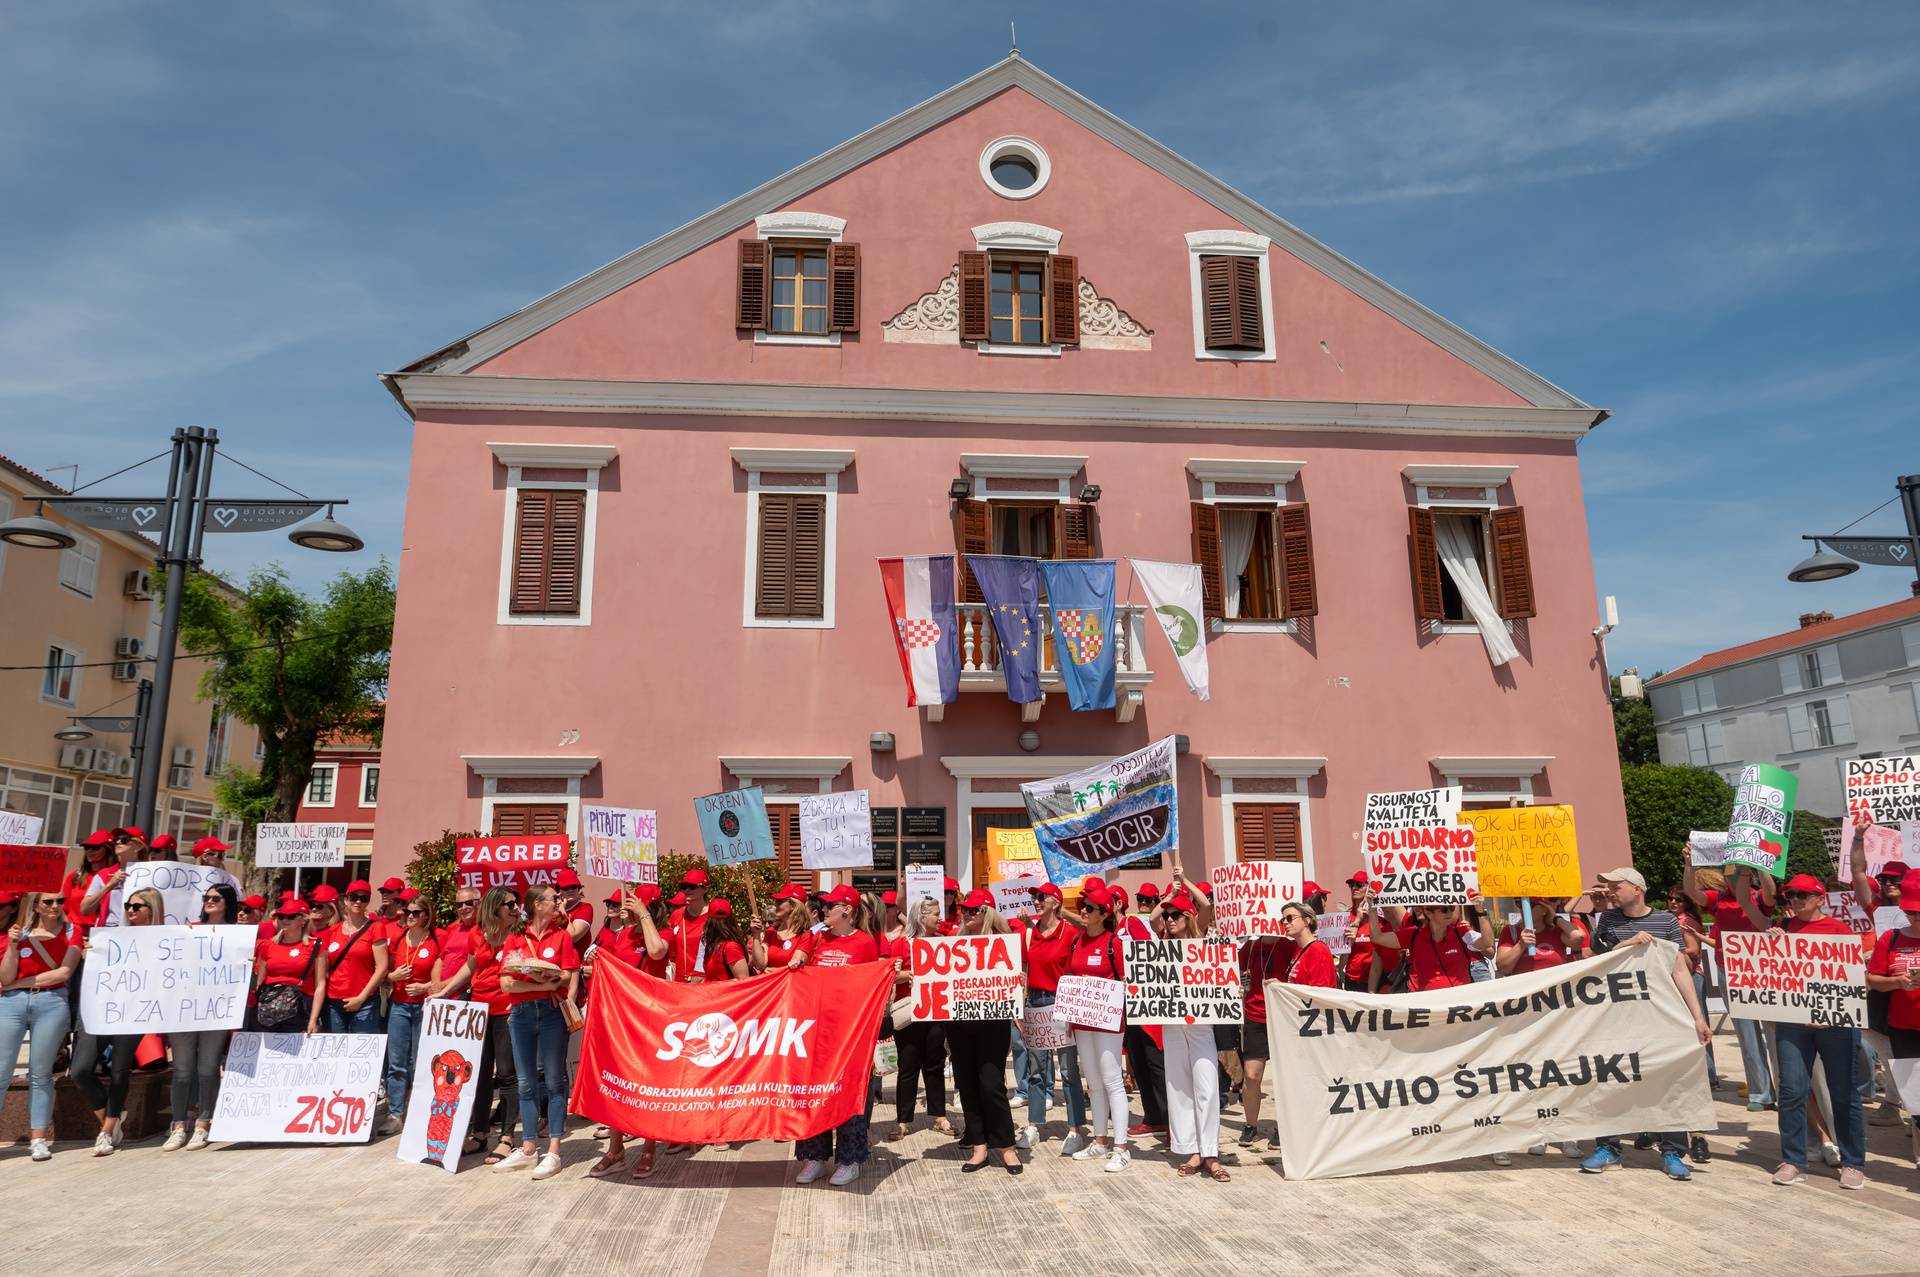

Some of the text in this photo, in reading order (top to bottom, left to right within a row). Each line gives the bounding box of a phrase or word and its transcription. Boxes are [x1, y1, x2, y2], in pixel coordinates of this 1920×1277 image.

[243, 508, 304, 516] BIOGRAD
[1849, 757, 1914, 775] DOSTA
[1368, 790, 1450, 806] SIGURNOST I
[1736, 785, 1783, 806] BILO
[1848, 786, 1908, 798] DIGNITET
[704, 793, 746, 812] OKRENI
[853, 794, 868, 812] JE
[1849, 798, 1870, 811] ZA
[1368, 805, 1438, 821] KVALITETA
[1508, 813, 1527, 832] JE
[1850, 810, 1874, 826] ZA
[294, 825, 316, 838] NIJE
[590, 809, 656, 840] PITAJTE VAŠE
[814, 836, 826, 851] DI
[832, 836, 844, 848] SI
[1000, 832, 1034, 844] STOP
[1070, 815, 1160, 861] TROGIR
[1367, 828, 1475, 852] SOLIDARNO
[461, 844, 562, 864] ZAGREB
[713, 838, 754, 862] PLOČU
[591, 857, 658, 882] VOLI SVOJE TETE
[1372, 852, 1395, 876] UZ
[1399, 852, 1448, 872] VAS
[1520, 853, 1534, 867] JE
[1541, 853, 1570, 868] 1000
[460, 872, 484, 888] JE
[489, 870, 518, 886] UZ
[1382, 872, 1466, 892] ZAGREB
[1216, 883, 1294, 902] USTRAJNI U
[999, 902, 1006, 912] je
[1216, 900, 1267, 920] BORBI ZA
[1220, 917, 1287, 938] SVOJA PRAV
[108, 936, 224, 966] DA SE TU
[912, 936, 1014, 976] DOSTA
[1126, 940, 1240, 968] JEDAN SVIJET
[1726, 934, 1792, 958] SVAKI
[1796, 938, 1864, 964] RADNIK
[1126, 964, 1240, 986] JEDNA BORBA
[1727, 957, 1848, 982] IMA PRAVO NA
[96, 970, 148, 995] RADI
[1059, 986, 1080, 996] KOJEM
[1085, 979, 1107, 990] SVIJET
[1728, 973, 1804, 992] ZAKONOM
[912, 981, 950, 1020] JE
[1148, 986, 1188, 1000] DALJE I
[1729, 986, 1844, 1012] PLAĆE I UVJETE
[106, 1002, 124, 1024] BI
[134, 1000, 164, 1023] ZA
[953, 1000, 1016, 1012] JEDAN SVIJET
[953, 1011, 980, 1020] JEDNA
[1127, 1000, 1242, 1020] ZAGREB UZ VAS
[427, 1002, 486, 1040] NEĆKO
[1298, 998, 1431, 1037] ŽIVILE
[230, 1034, 261, 1058] OD
[349, 1034, 380, 1058] ZA
[347, 1062, 372, 1085] DO
[1328, 1052, 1642, 1115] ŽIVIO ŠTRAJK!
[601, 1070, 639, 1092] SINDIKAT
[638, 1085, 716, 1098] OBRAZOVANJA,
[718, 1084, 756, 1096] MEDIJA
[758, 1083, 763, 1093] I
[764, 1082, 806, 1095] KULTURE
[600, 1084, 620, 1101] TRADE
[622, 1094, 648, 1110] UNION
[648, 1101, 662, 1111] OF
[662, 1101, 716, 1112] EDUCATION,
[718, 1098, 747, 1109] MEDIA
[748, 1096, 769, 1106] AND
[770, 1096, 808, 1109] CULTURE
[808, 1098, 822, 1108] OF
[1412, 1108, 1560, 1136] BRID MAZ RIS
